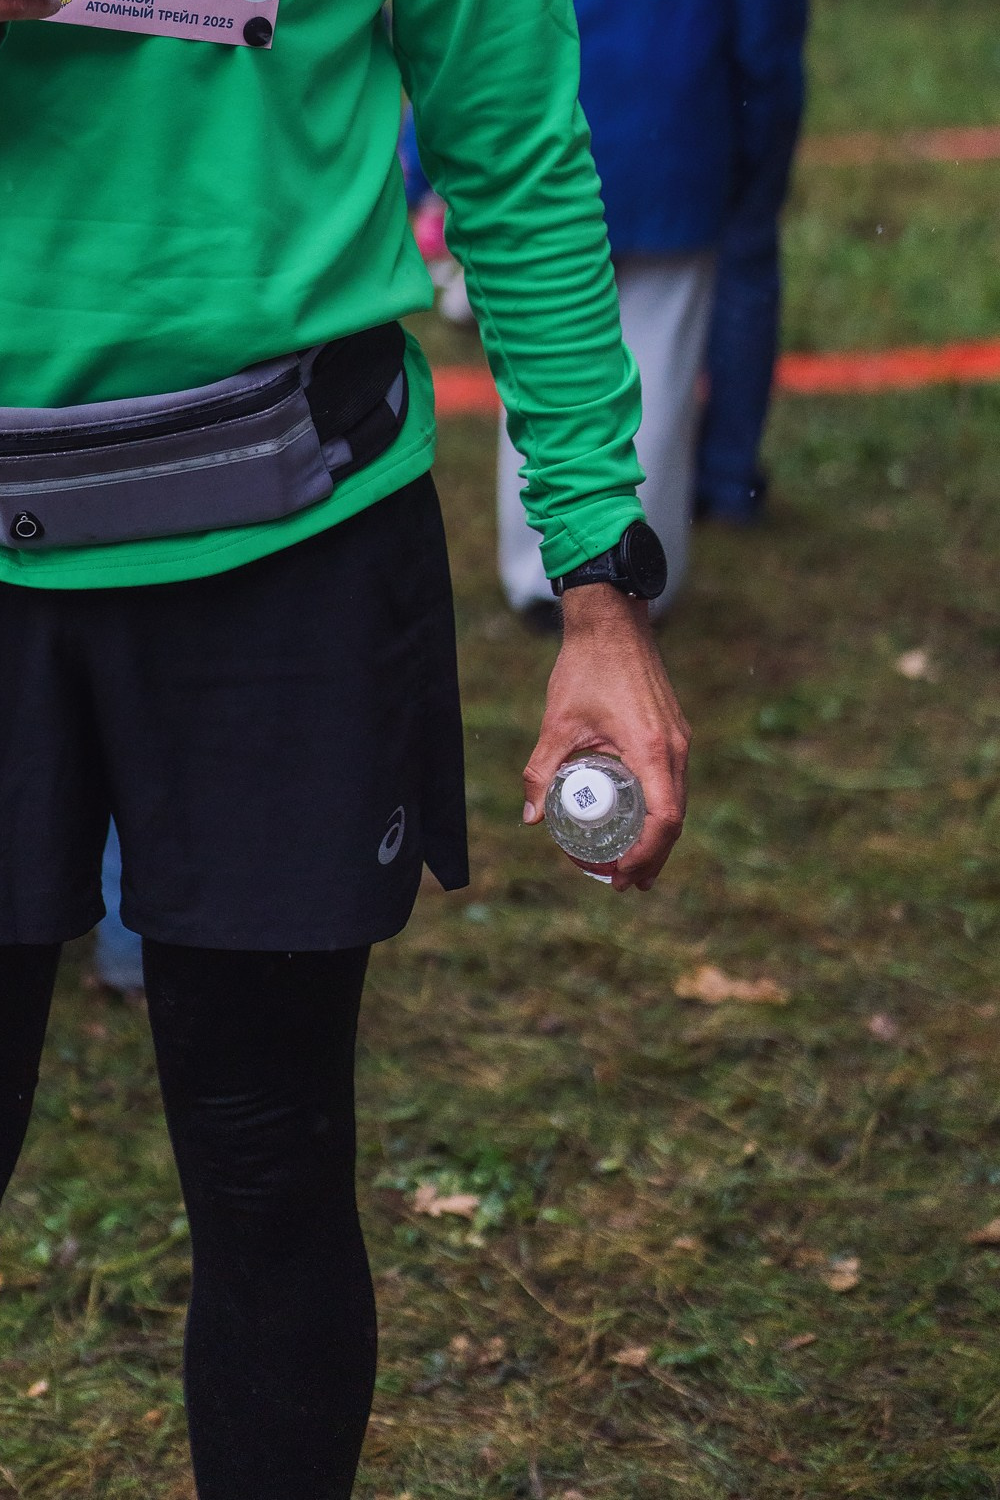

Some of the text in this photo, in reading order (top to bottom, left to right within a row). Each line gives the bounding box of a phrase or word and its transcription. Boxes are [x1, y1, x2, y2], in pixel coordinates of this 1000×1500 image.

[85, 1, 235, 29] АТОМНЫЙ ТРЕЙЛ 2025
